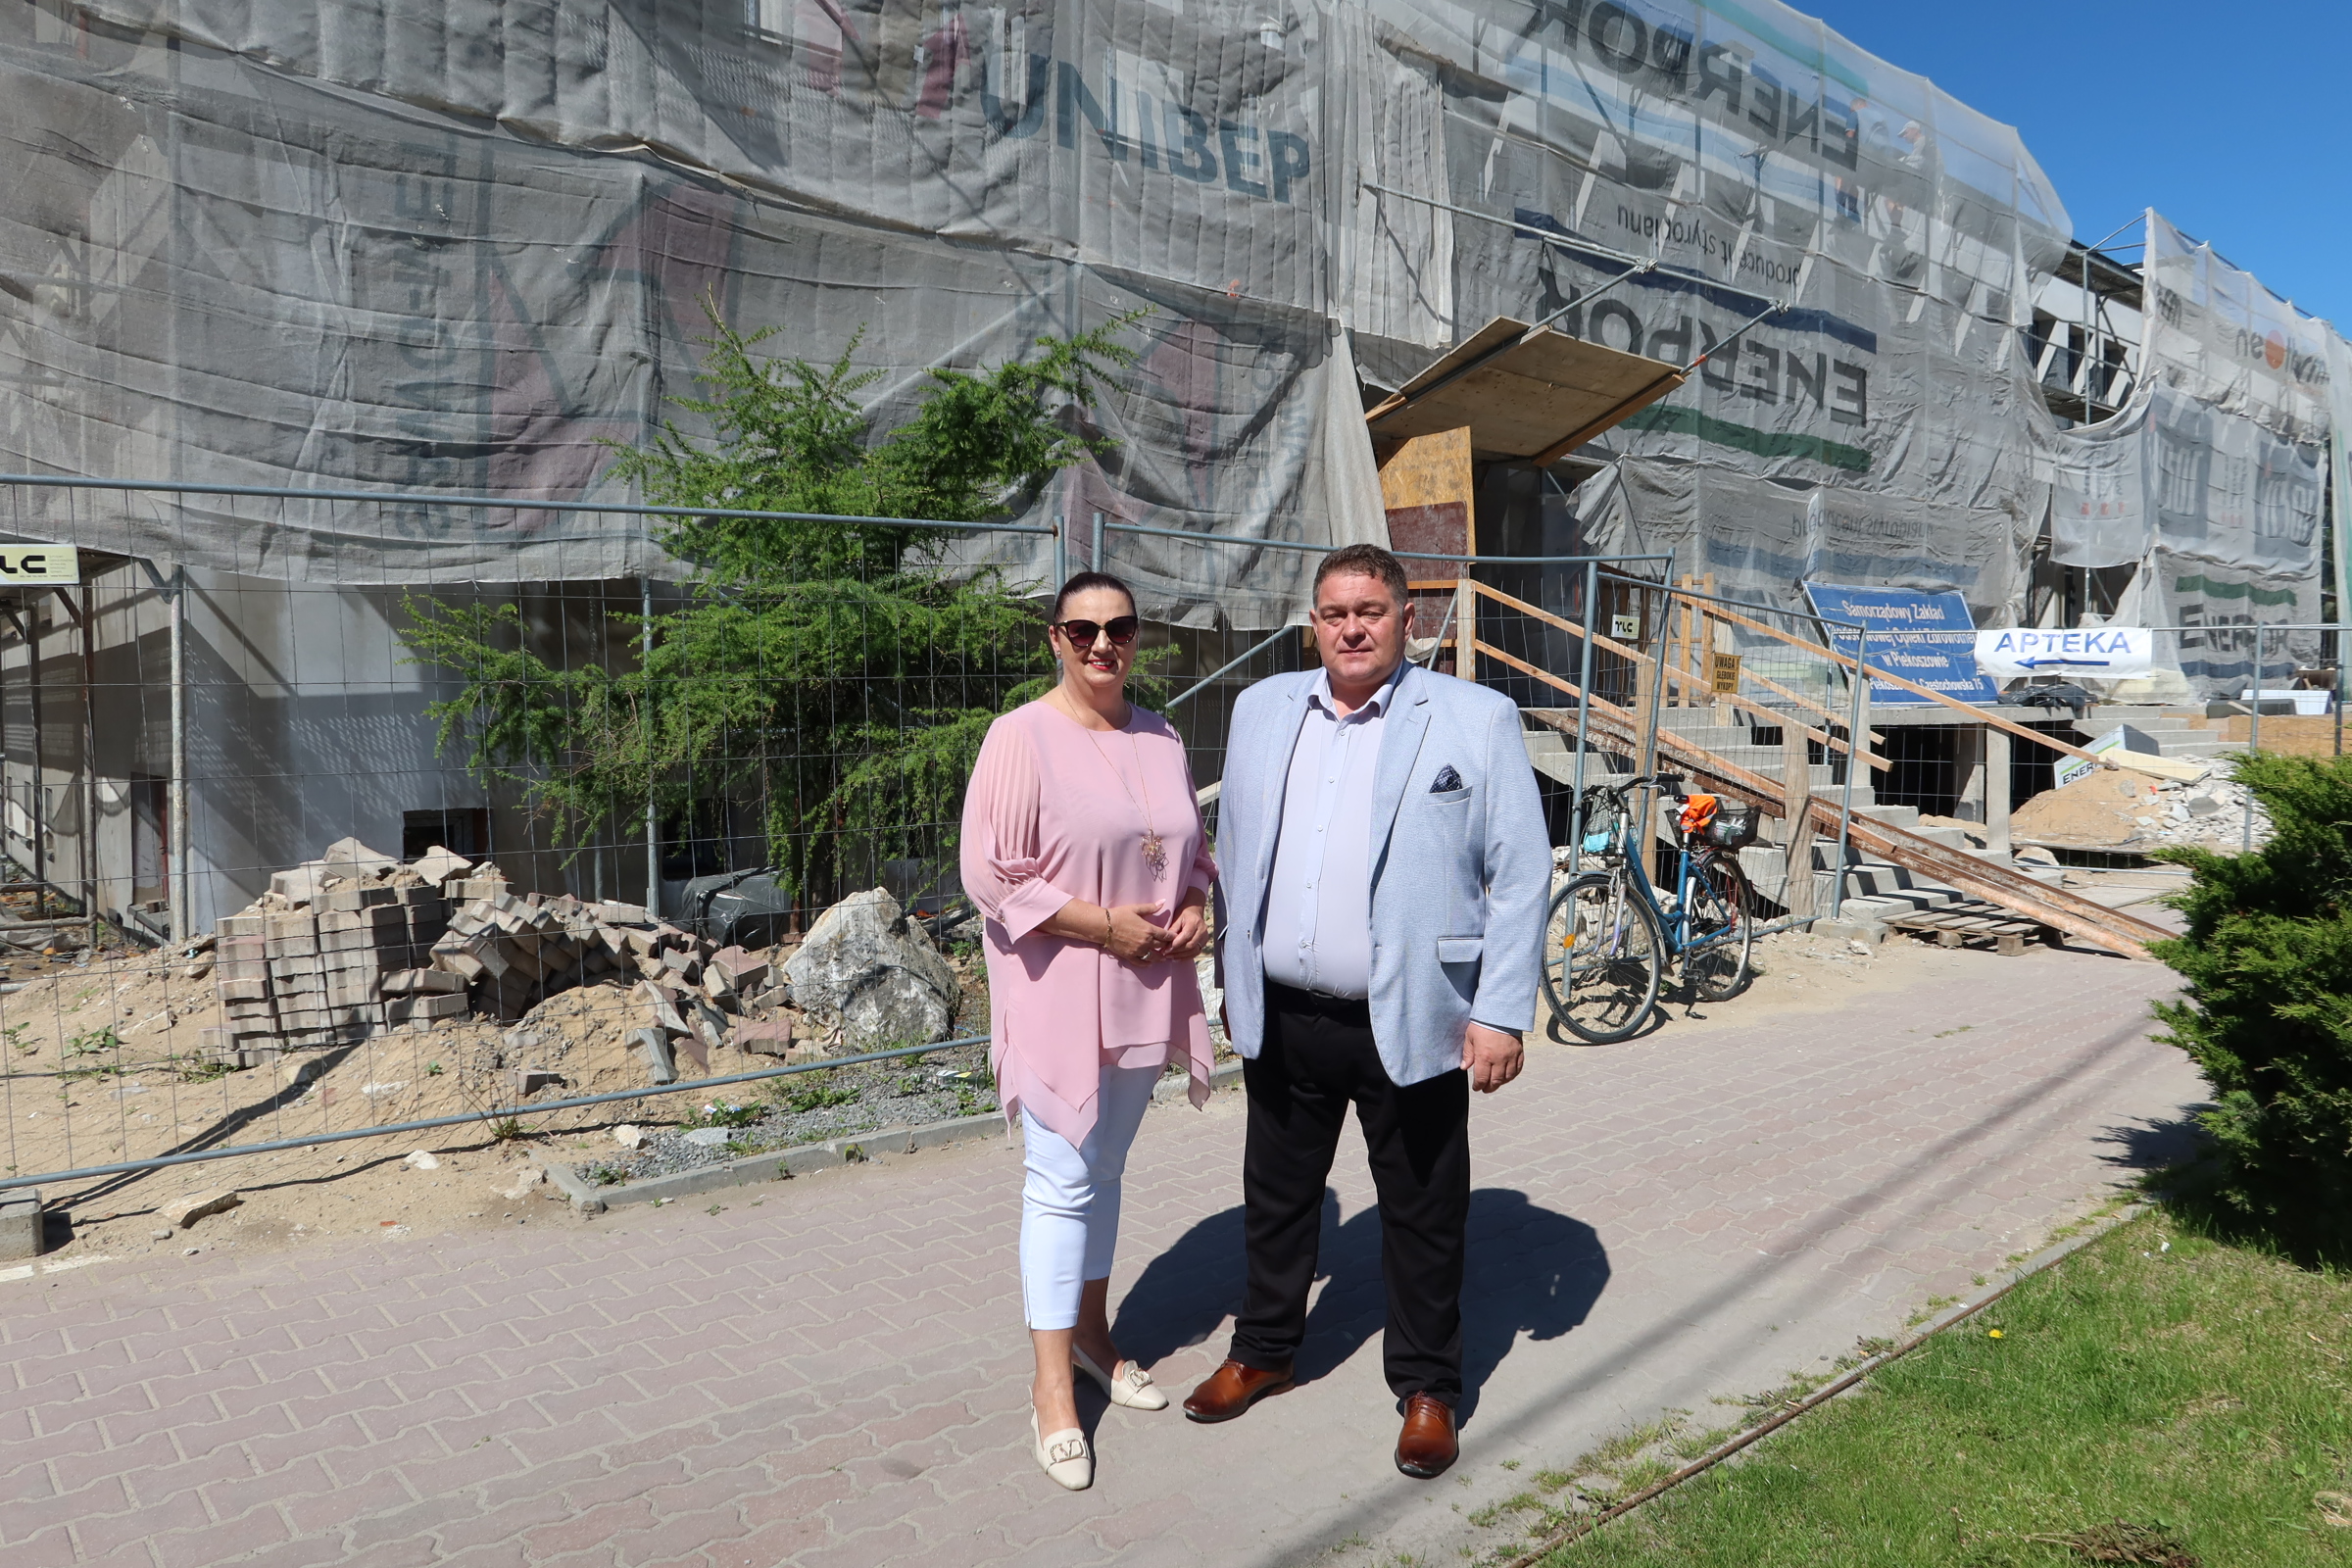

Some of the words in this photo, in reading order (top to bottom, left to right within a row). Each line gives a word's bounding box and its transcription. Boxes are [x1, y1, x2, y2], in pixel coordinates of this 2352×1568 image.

[980, 41, 1310, 205] UNIBEP
[1535, 266, 1868, 428] ENERPOR
[1841, 599, 1912, 623] Samorządowy
[1911, 603, 1945, 620] Zakład
[1993, 631, 2132, 654] APTEKA
[1715, 656, 1735, 669] UWAGA
[1882, 655, 1892, 667] w
[1890, 651, 1949, 667] Piekoszowie
[1972, 677, 1984, 690] 75
